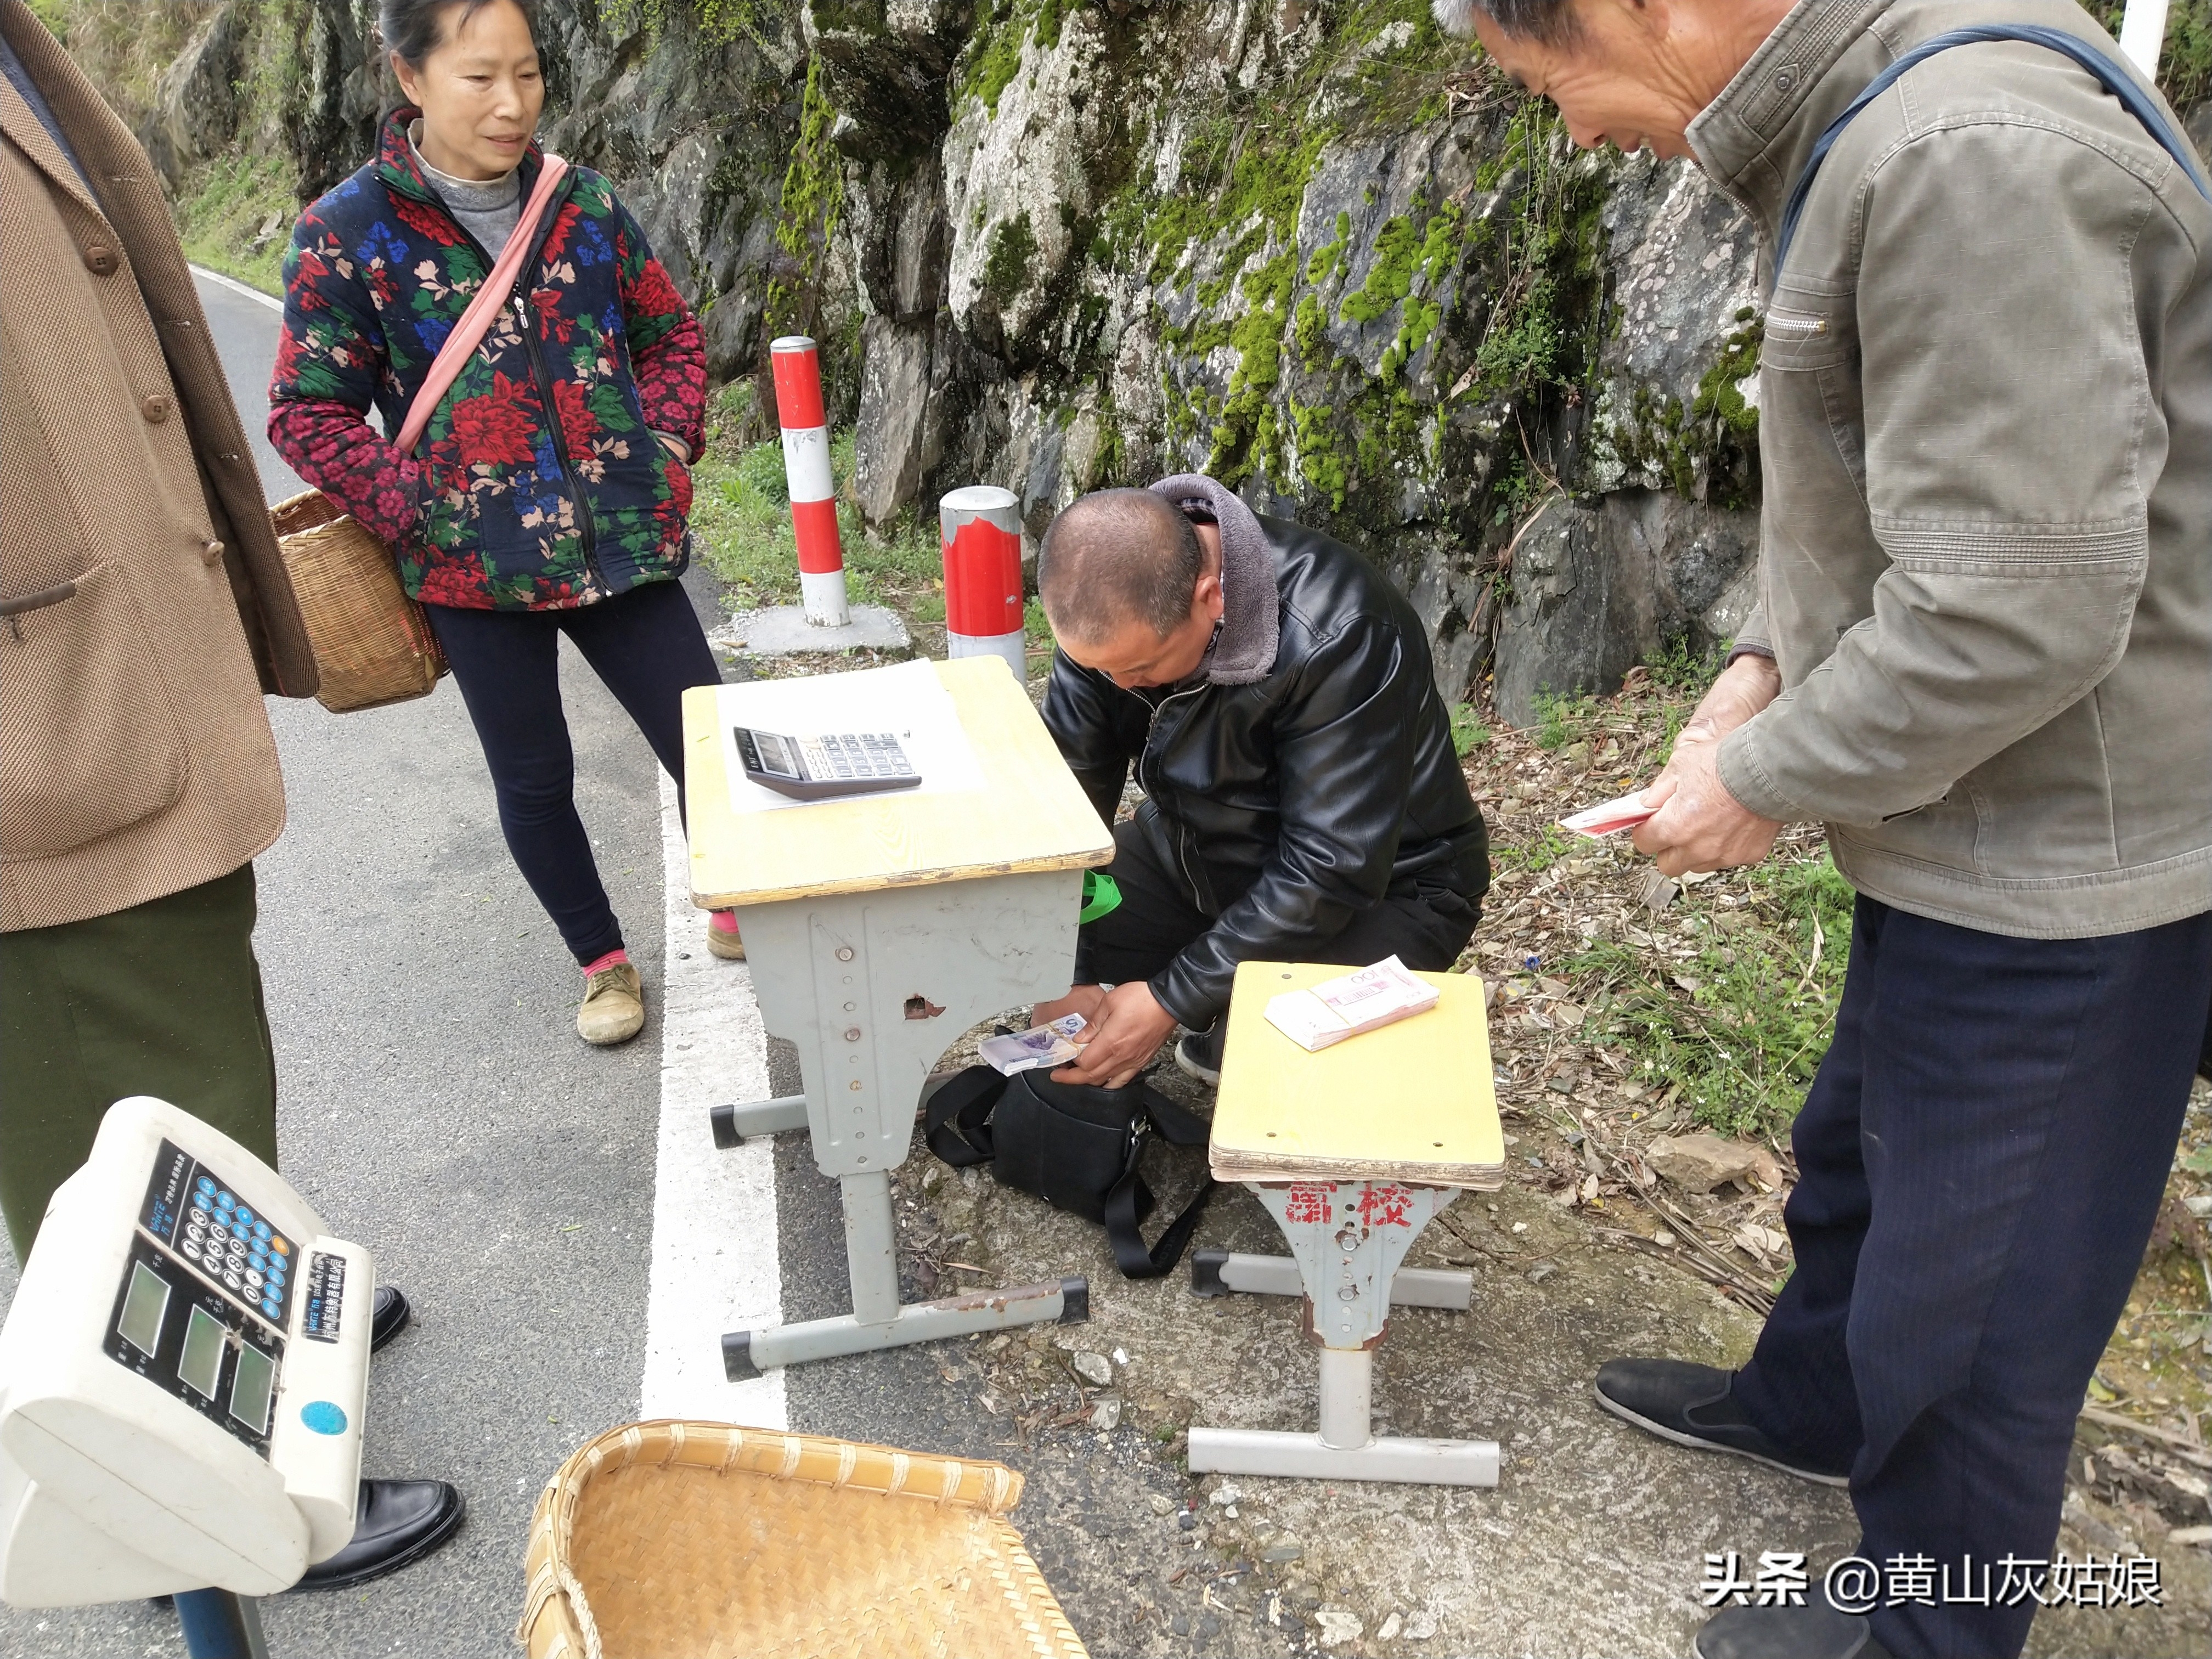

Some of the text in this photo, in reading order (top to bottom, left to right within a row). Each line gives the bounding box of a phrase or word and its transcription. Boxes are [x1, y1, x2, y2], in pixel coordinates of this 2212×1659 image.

[1066, 1019, 1079, 1028] 5
[194, 1211, 205, 1224] 3
[190, 1226, 203, 1240] 2
[213, 1226, 225, 1239] 6
[186, 1243, 198, 1254] 1
[209, 1242, 221, 1255] 5
[232, 1241, 244, 1254] 9
[206, 1257, 218, 1269] 4
[229, 1257, 241, 1269] 8
[225, 1272, 238, 1285] 7
[246, 1291, 258, 1301] 0
